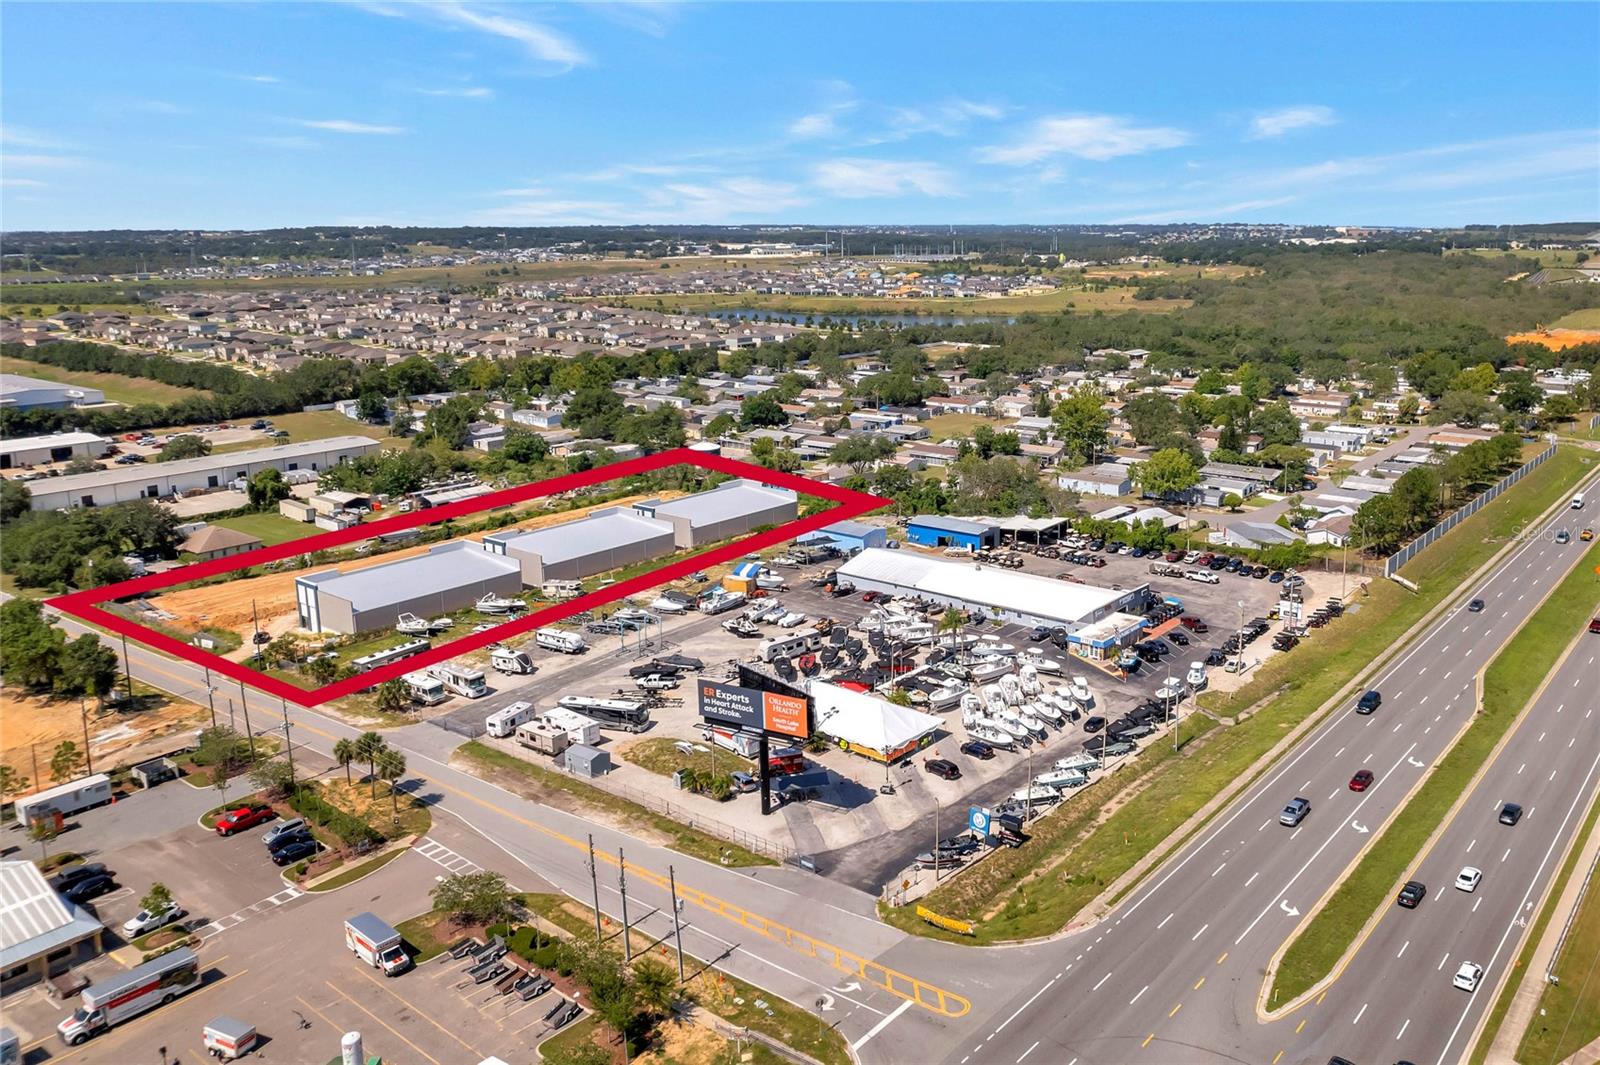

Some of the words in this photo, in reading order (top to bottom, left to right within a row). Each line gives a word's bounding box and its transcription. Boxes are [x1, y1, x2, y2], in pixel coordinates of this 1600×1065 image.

[704, 687, 715, 697] ER
[716, 689, 750, 704] Experts
[711, 698, 731, 708] Heart
[731, 702, 754, 713] Attack
[768, 697, 802, 710] ORLANDO
[718, 708, 742, 718] Stroke.
